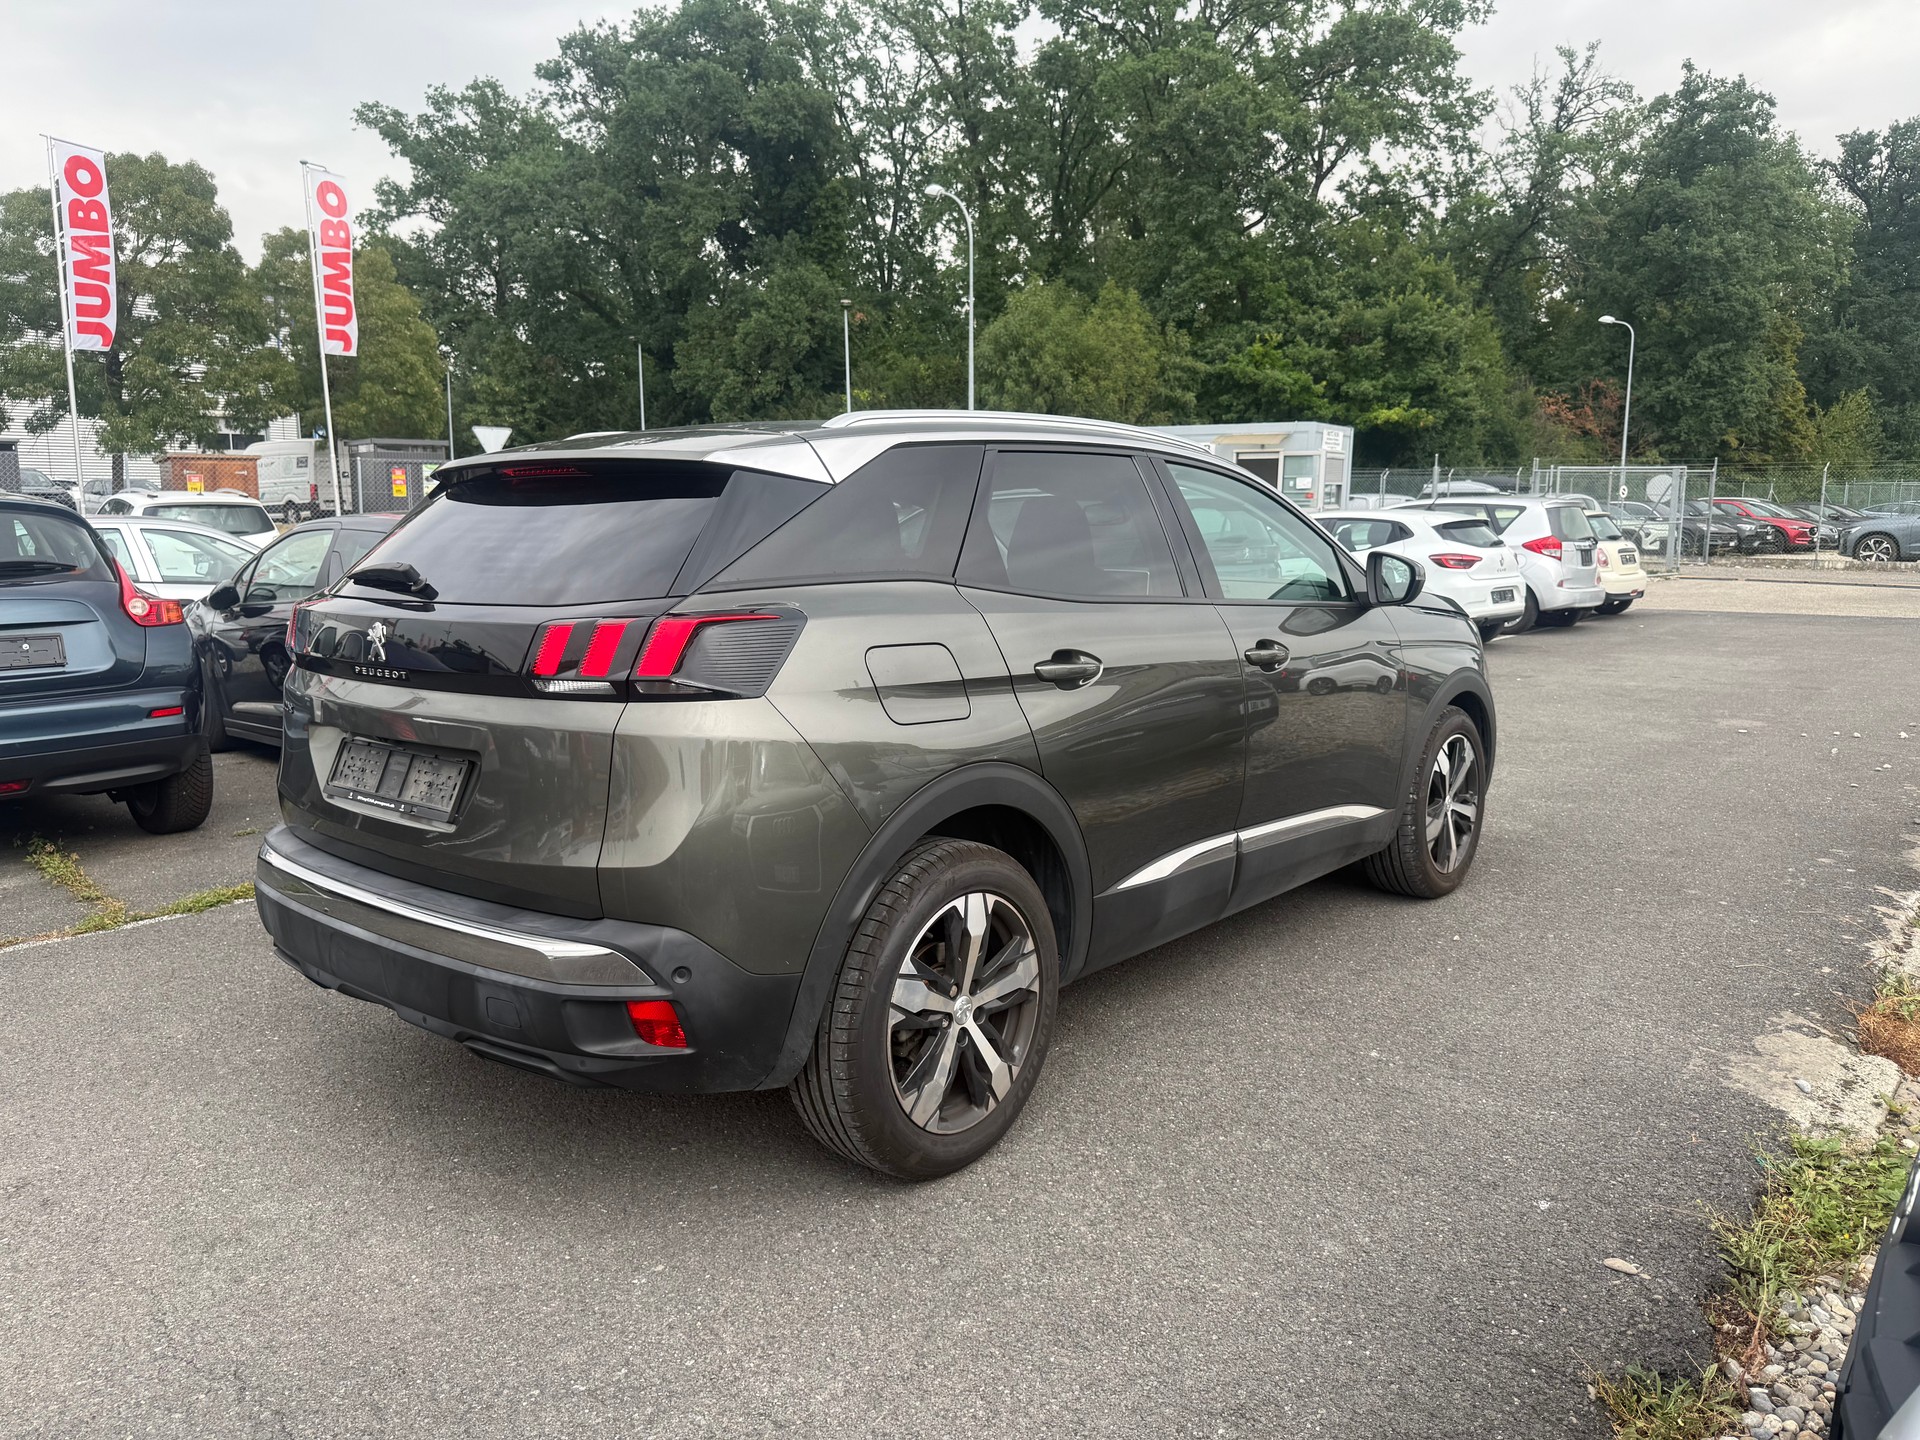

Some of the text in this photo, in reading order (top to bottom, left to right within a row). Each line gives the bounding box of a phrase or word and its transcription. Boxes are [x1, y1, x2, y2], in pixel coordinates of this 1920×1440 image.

[64, 154, 115, 347] JUMBO
[316, 180, 354, 353] JUMBO
[354, 665, 407, 679] PEUGEOT
[1014, 1001, 1050, 1102] DUNLOP
